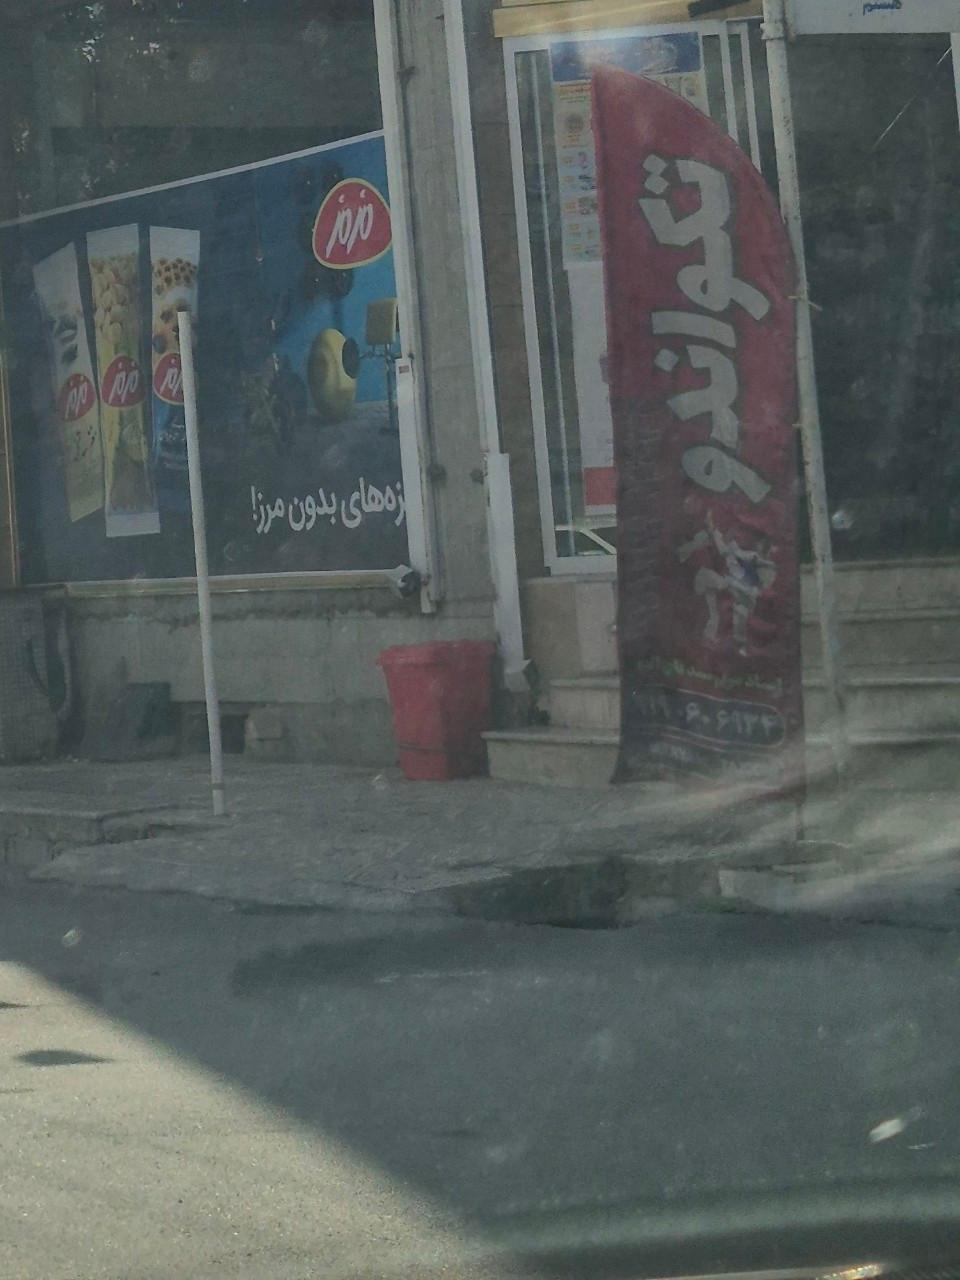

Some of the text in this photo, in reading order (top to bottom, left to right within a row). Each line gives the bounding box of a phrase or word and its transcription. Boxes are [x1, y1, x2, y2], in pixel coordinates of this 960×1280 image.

[638, 152, 772, 505] تکواندو
[250, 484, 286, 535] مرز!
[288, 486, 337, 532] بدون
